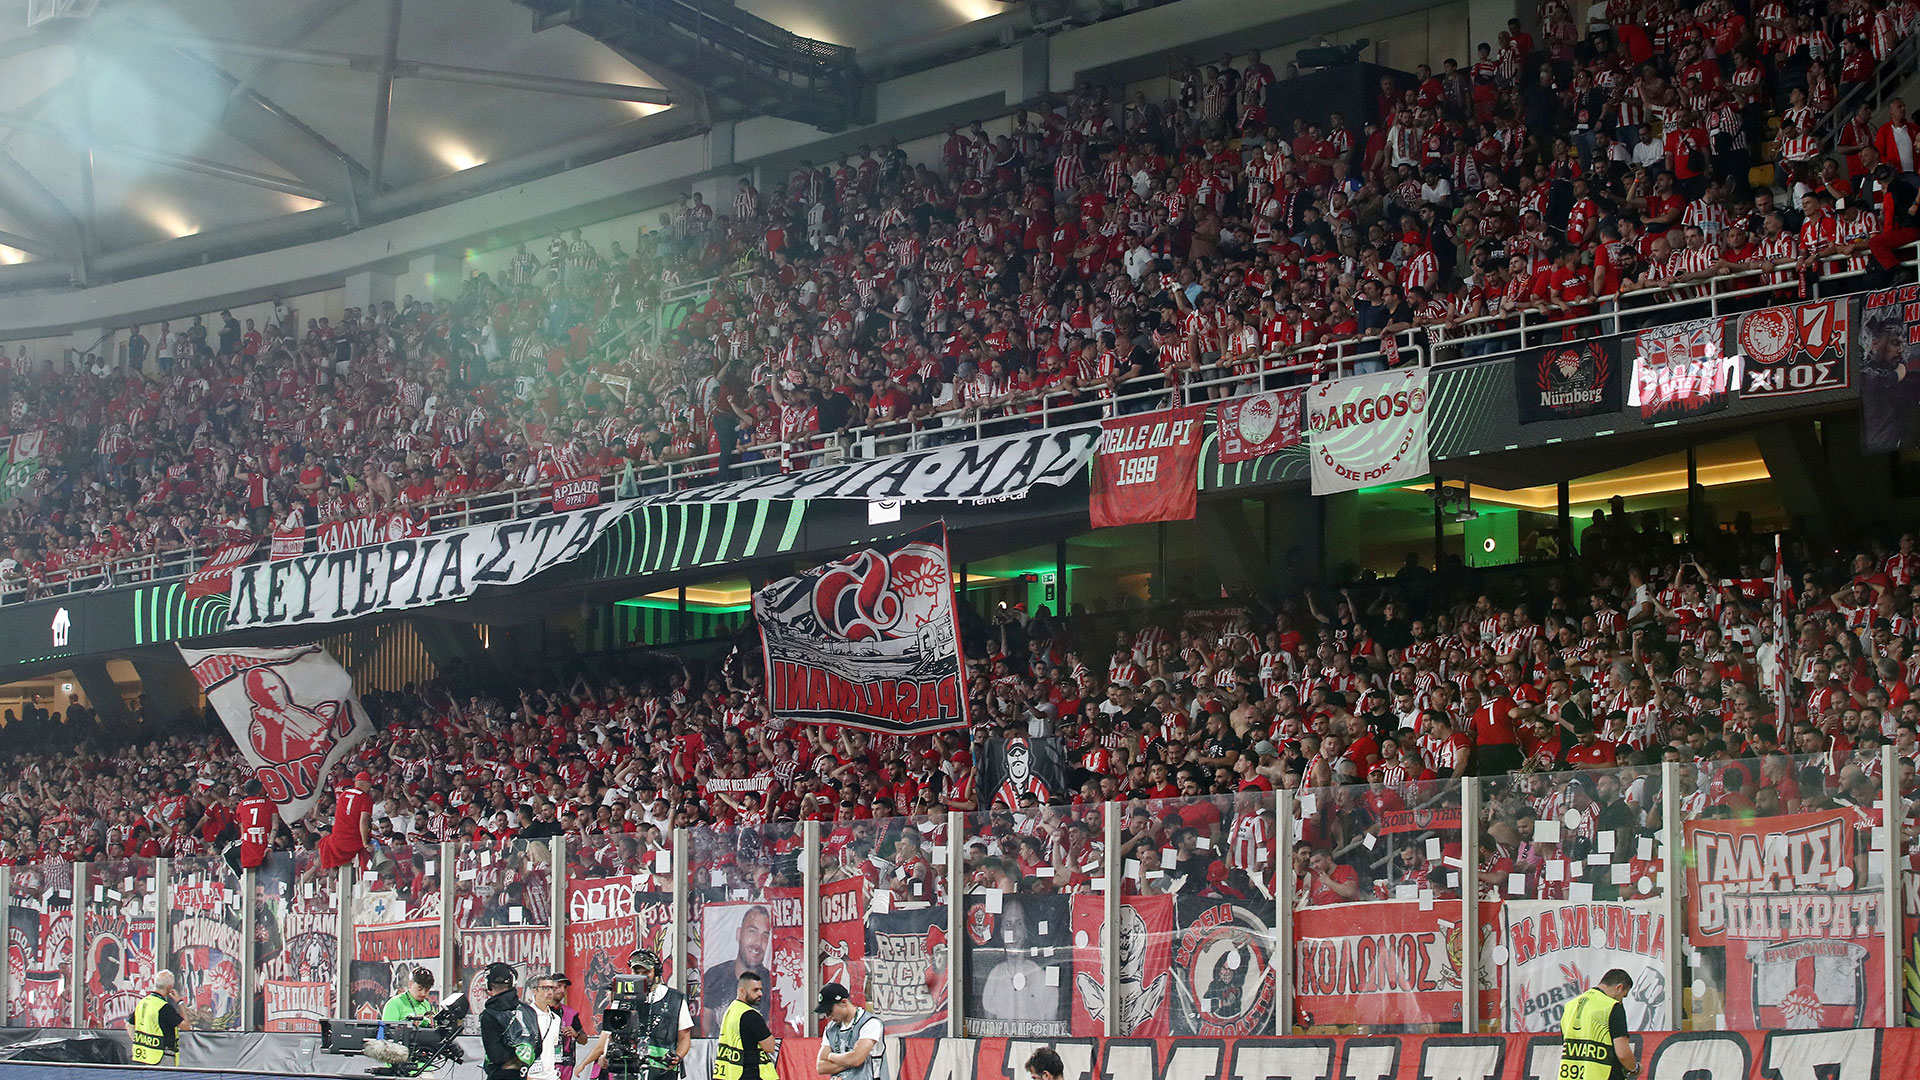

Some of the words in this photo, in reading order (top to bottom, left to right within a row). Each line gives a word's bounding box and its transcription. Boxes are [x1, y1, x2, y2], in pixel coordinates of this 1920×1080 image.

[1803, 307, 1828, 347] 7
[1748, 361, 1838, 392] ΧΙΟΣ
[1541, 389, 1602, 406] Nürnberg
[1150, 419, 1195, 449] ALPI
[1320, 445, 1334, 466] TO
[1335, 465, 1361, 481] DIE
[1364, 462, 1391, 481] FOR
[1392, 428, 1414, 463] YOU
[1116, 455, 1159, 486] 1999
[554, 480, 599, 503] ΑΡΙΔΑΙΑ
[227, 532, 470, 625] ΛΕΥΤΕΡΙΑ
[1482, 697, 1496, 725] 7
[250, 807, 258, 825] 7
[345, 793, 355, 815] 7
[1175, 903, 1233, 968] ΒΟΡΕΙΑ
[874, 960, 927, 985] SICK
[1302, 932, 1438, 995] ΚΟΛΩΝΟΣ
[873, 985, 935, 1015] NESS
[1524, 980, 1581, 1016] BORN
[1541, 1006, 1563, 1027] TO
